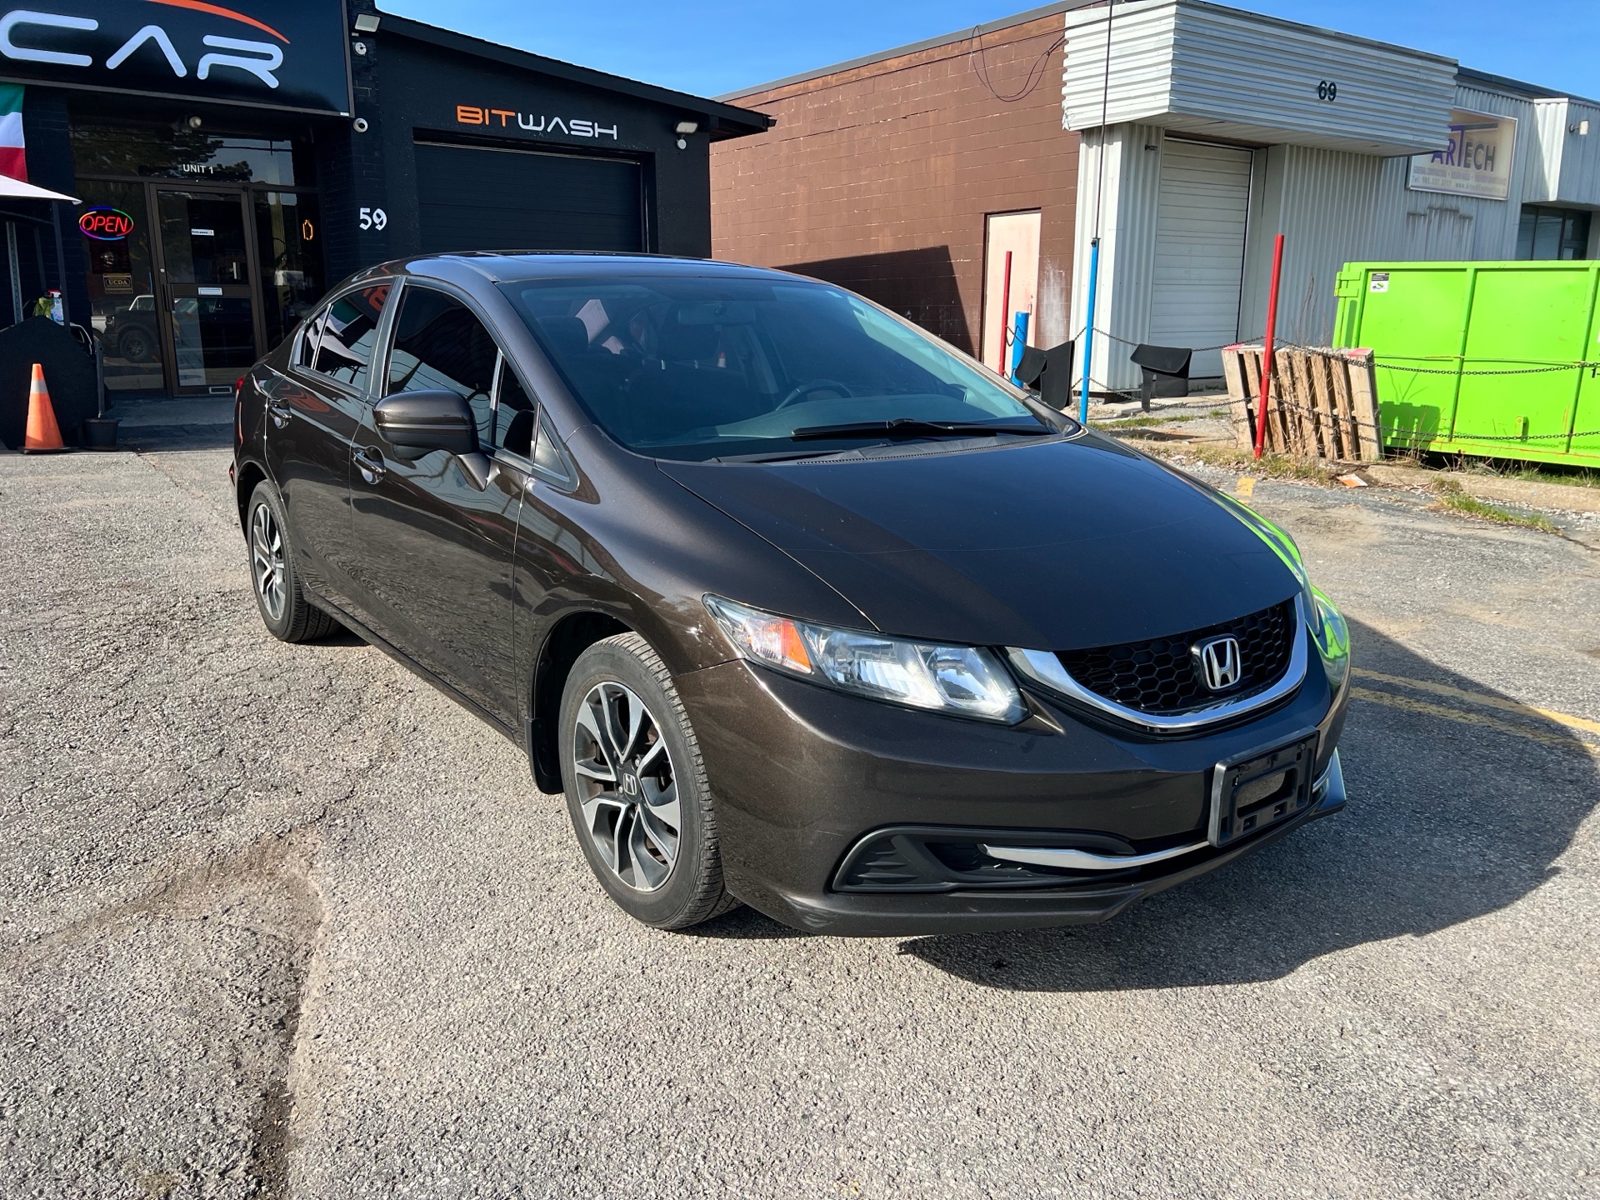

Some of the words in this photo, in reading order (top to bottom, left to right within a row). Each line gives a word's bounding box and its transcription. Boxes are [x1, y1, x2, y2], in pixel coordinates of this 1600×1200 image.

[0, 9, 284, 89] CAR
[1317, 80, 1337, 101] 69
[456, 105, 618, 141] BITWASH
[182, 163, 207, 174] UNIT
[208, 166, 214, 175] 1
[81, 215, 128, 233] OPEN
[359, 207, 388, 231] 59
